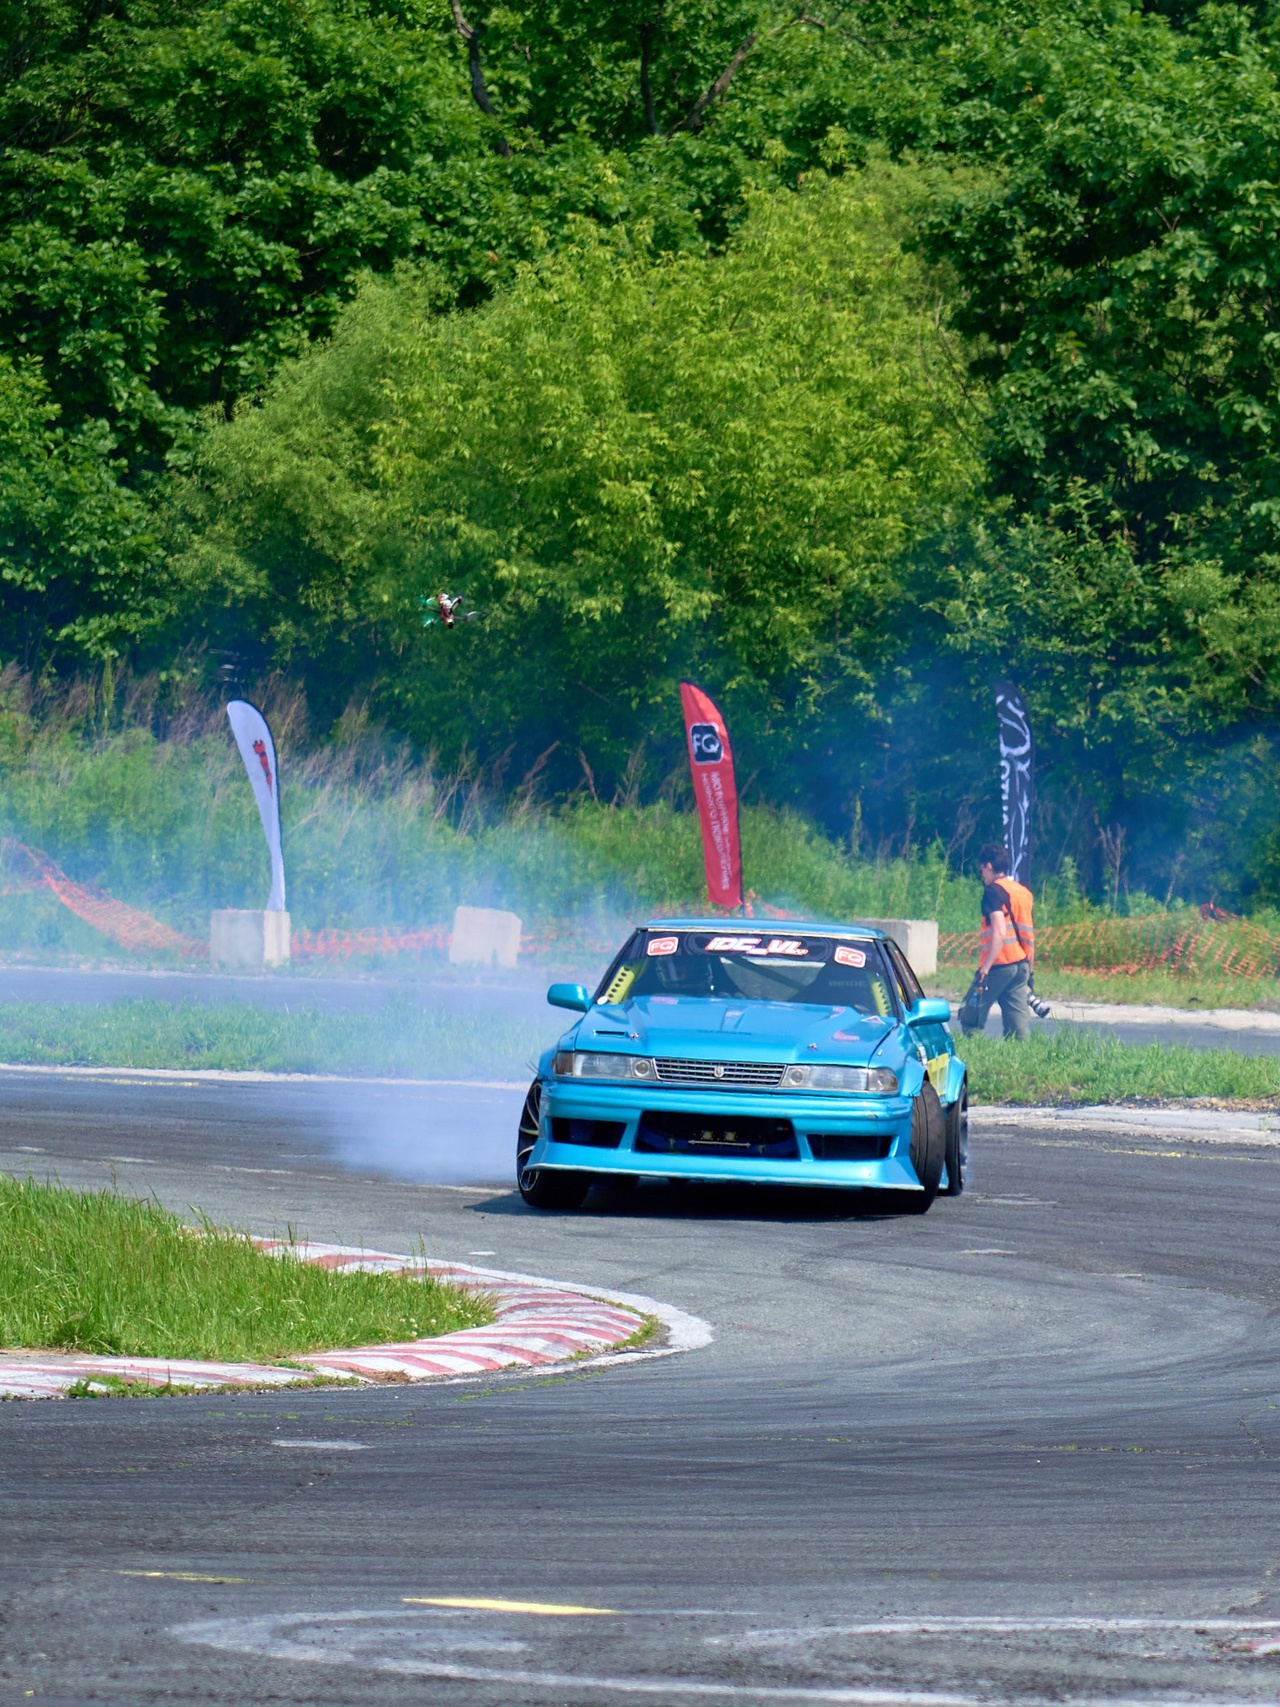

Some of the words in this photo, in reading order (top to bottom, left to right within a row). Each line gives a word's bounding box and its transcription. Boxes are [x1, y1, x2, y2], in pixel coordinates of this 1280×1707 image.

[693, 733, 720, 754] FQ
[650, 940, 675, 952] FQ
[838, 951, 862, 965] FQ
